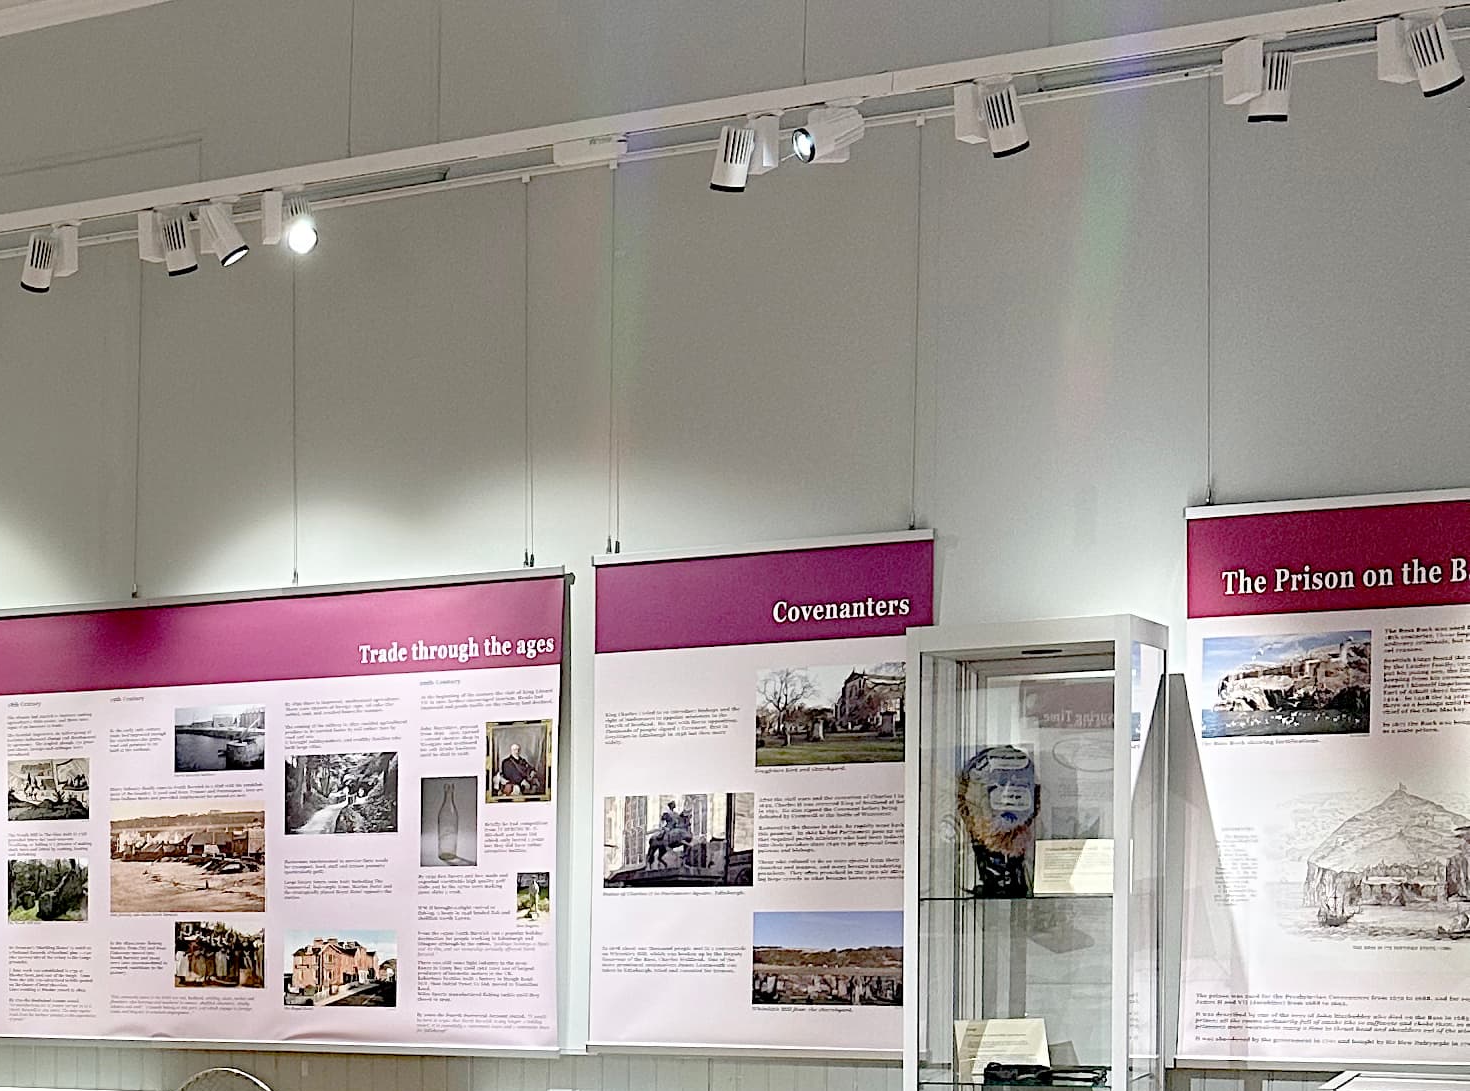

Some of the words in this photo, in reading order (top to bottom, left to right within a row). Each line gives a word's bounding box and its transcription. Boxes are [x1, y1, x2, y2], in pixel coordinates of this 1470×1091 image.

[1221, 568, 1266, 595] The
[1273, 564, 1355, 593] Prison
[1362, 568, 1394, 588] on
[1401, 558, 1442, 585] the
[1450, 557, 1470, 582] B
[772, 596, 910, 623] Covenanters
[357, 641, 408, 664] Trade
[411, 636, 480, 662] through
[483, 635, 512, 657] the
[516, 636, 555, 660] ages
